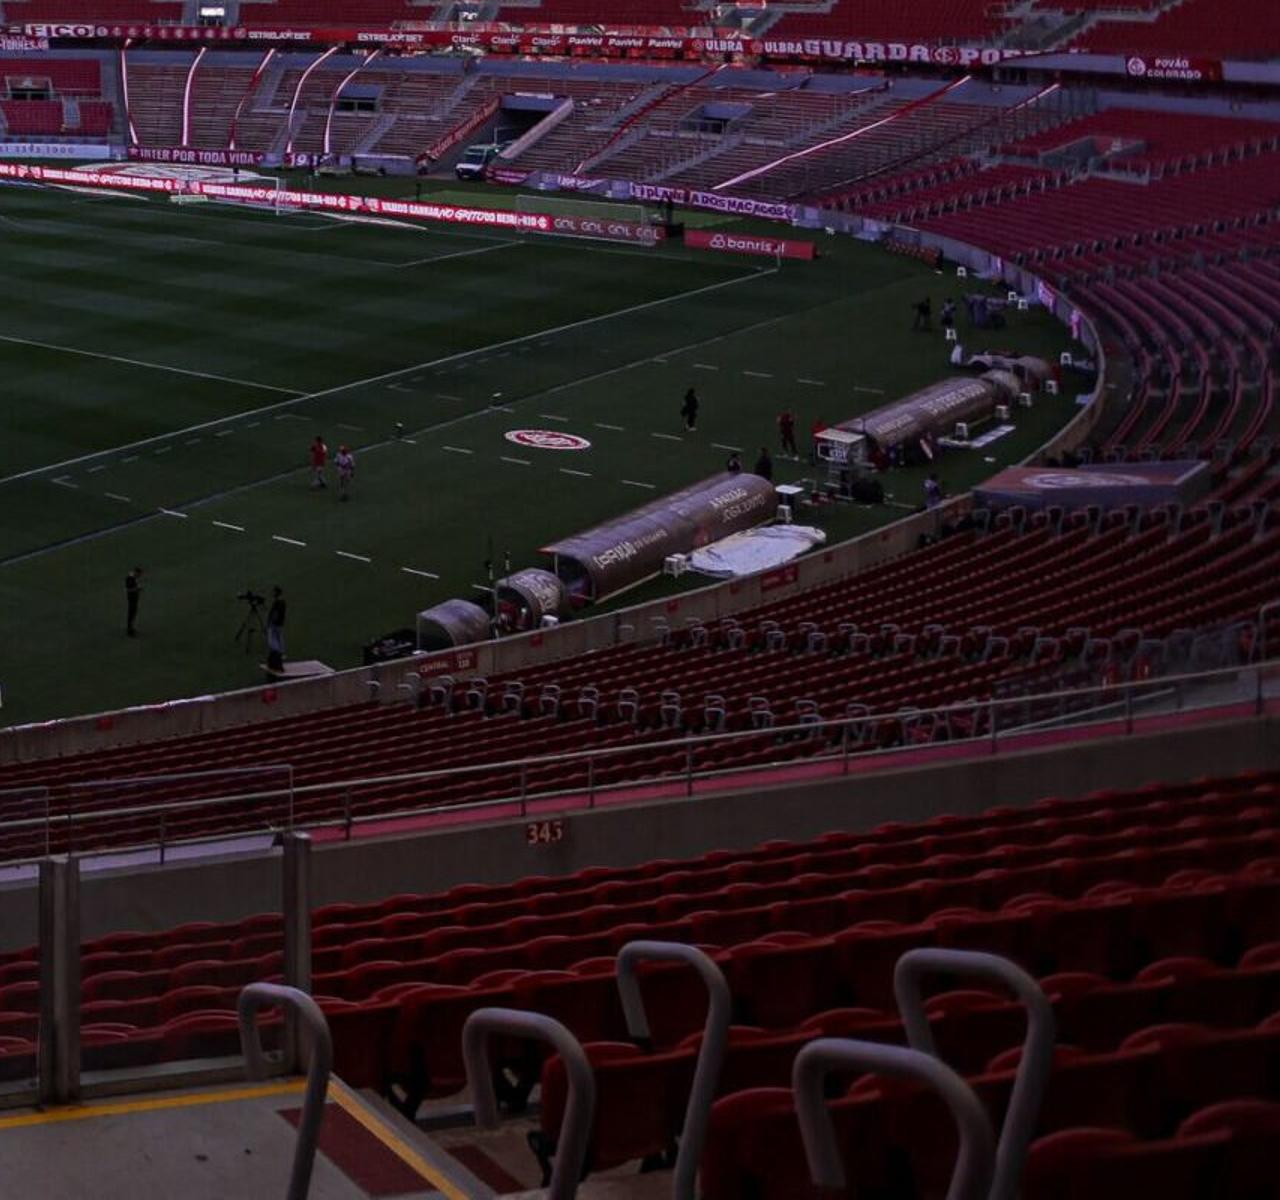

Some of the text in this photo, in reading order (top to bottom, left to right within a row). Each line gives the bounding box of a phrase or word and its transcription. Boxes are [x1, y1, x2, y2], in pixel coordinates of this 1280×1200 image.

[705, 40, 744, 52] ULBRA
[764, 41, 803, 54] ULBRA
[804, 39, 930, 63] GUARDA
[1154, 57, 1189, 68] POVÃO
[140, 150, 255, 164] INTER POR TODA VIDA
[701, 195, 727, 209] DOS
[553, 217, 576, 230] GOL
[580, 220, 604, 234] GOL
[607, 223, 632, 237] GOL
[528, 821, 563, 844] 345
